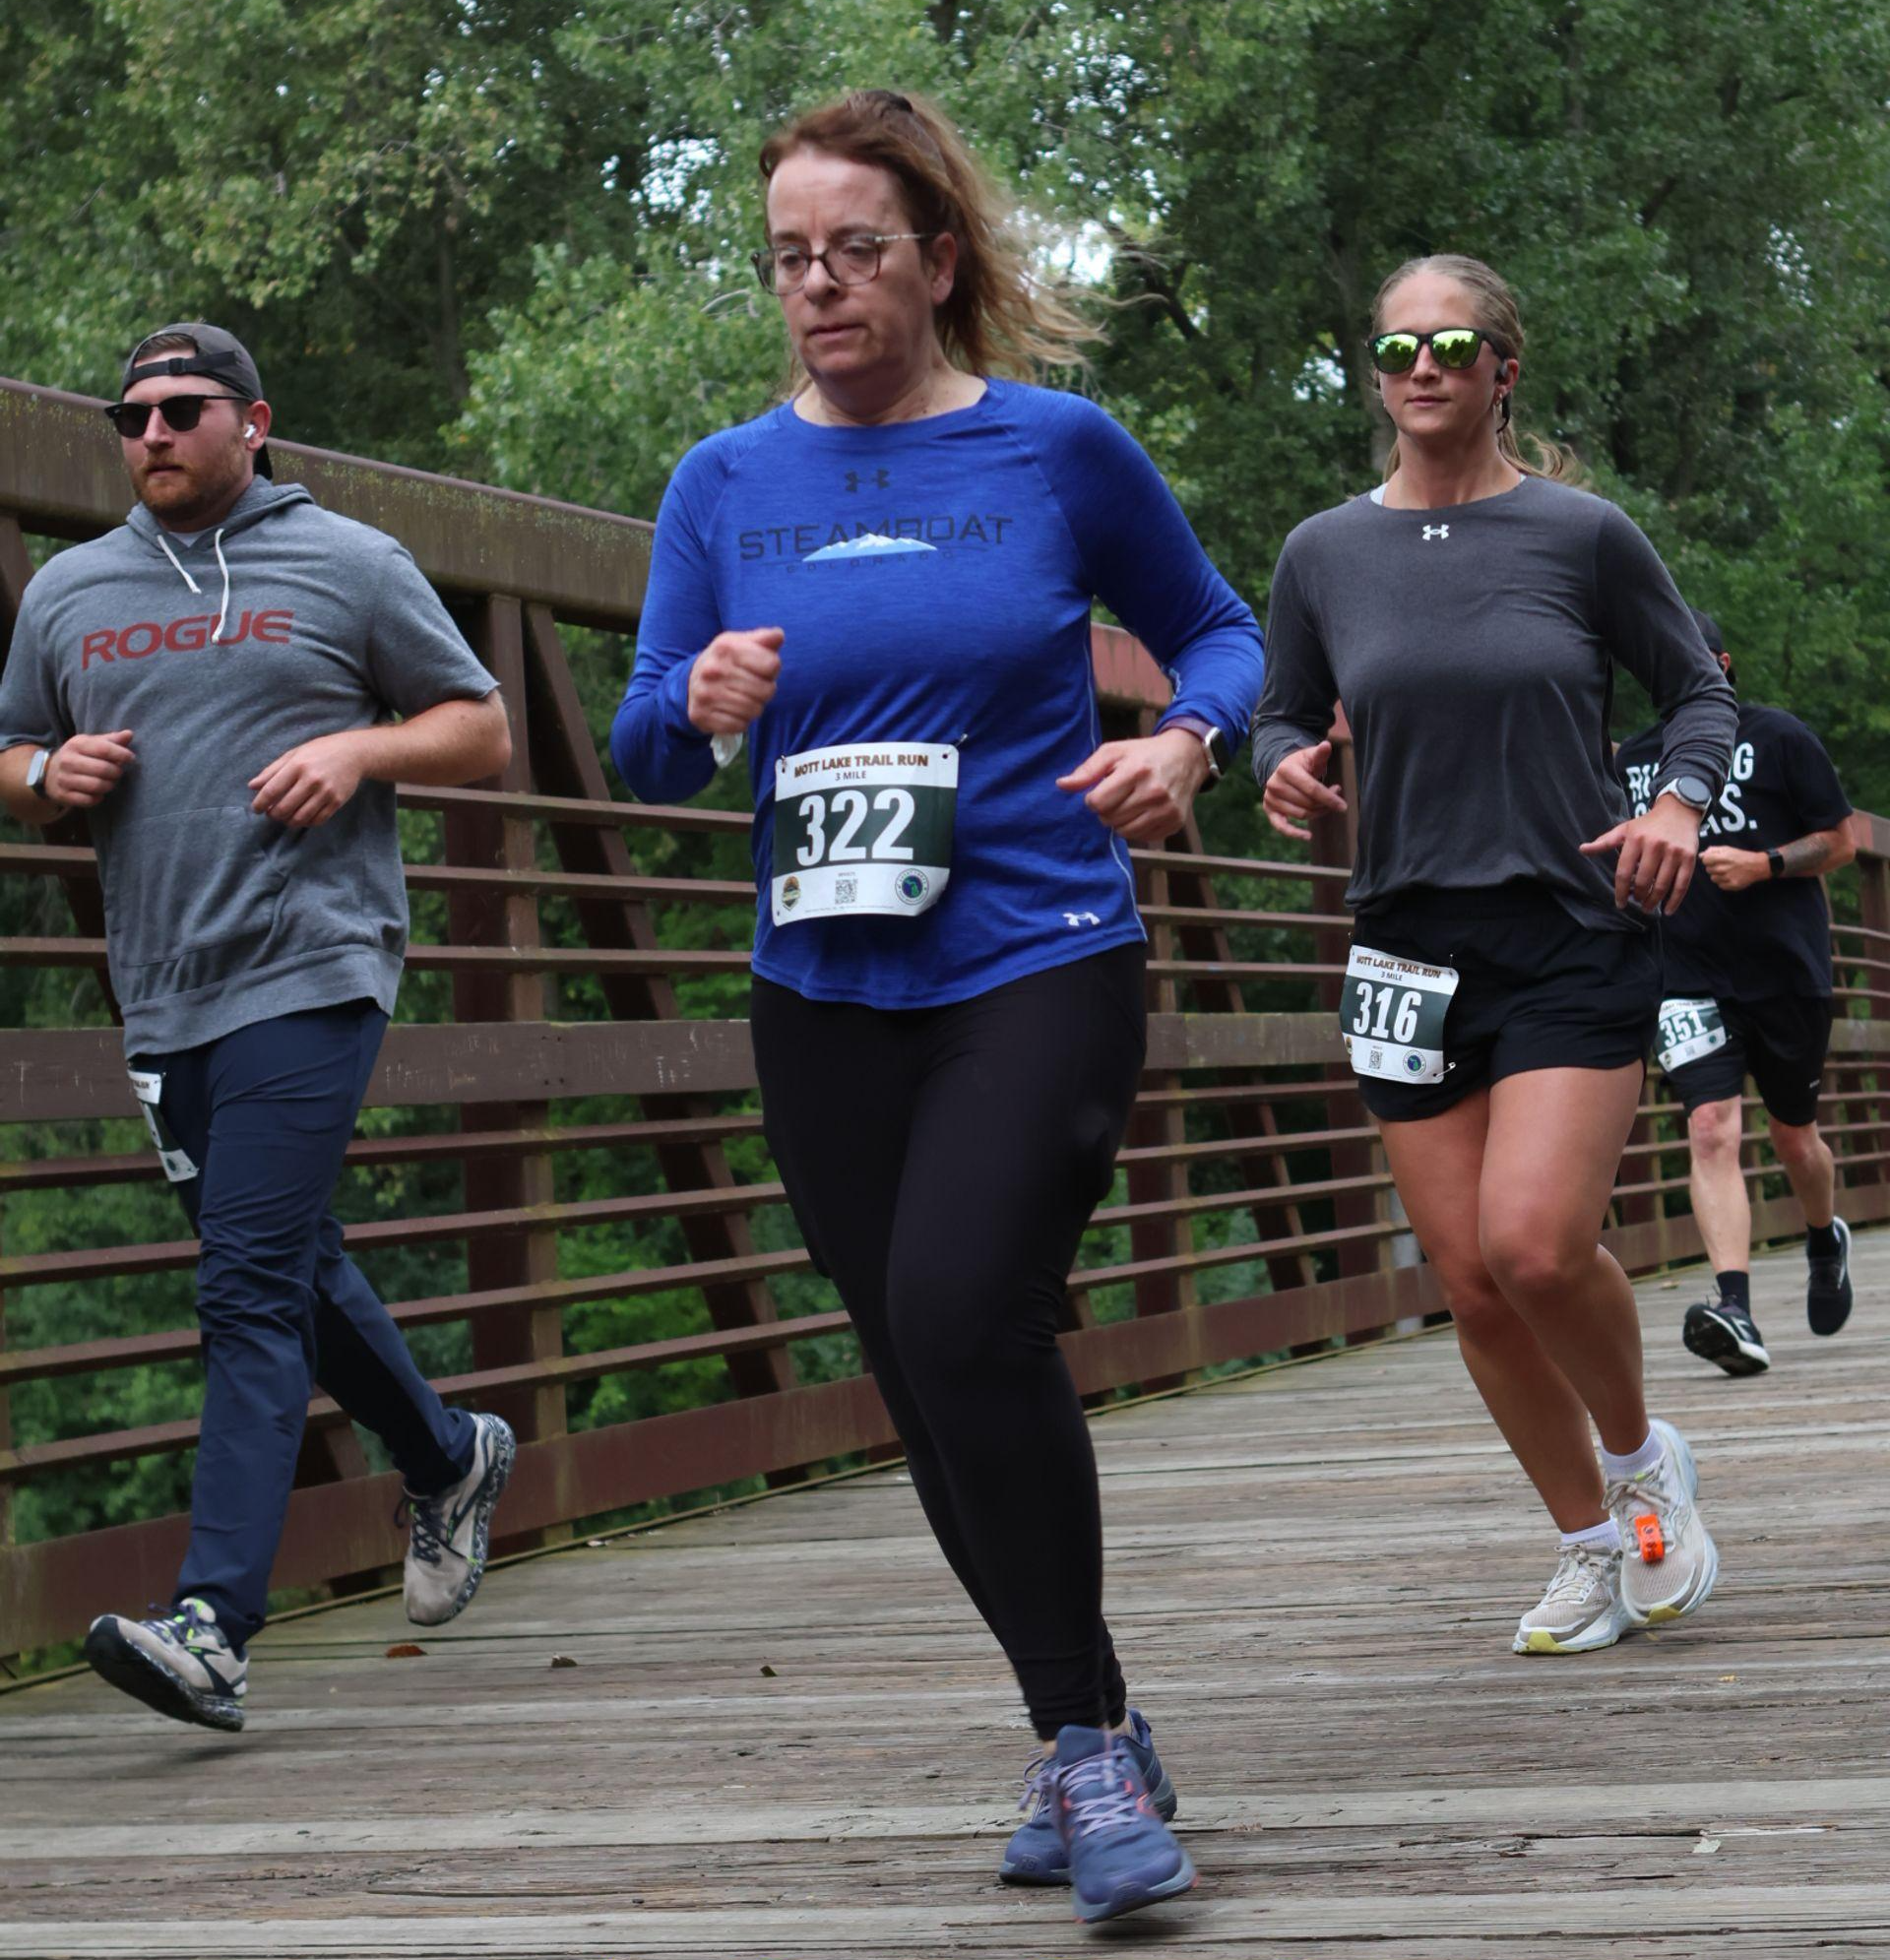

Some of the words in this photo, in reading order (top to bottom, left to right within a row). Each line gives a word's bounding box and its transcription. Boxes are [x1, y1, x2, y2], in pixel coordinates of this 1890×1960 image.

[739, 514, 1013, 560] STEAMBOAT
[82, 609, 294, 670] ROGUE
[793, 761, 819, 778] MOTT
[822, 756, 851, 771] LAKE
[854, 754, 894, 768] TRAIL
[897, 754, 929, 767] RUN
[835, 772, 842, 782] 3
[844, 771, 866, 780] MILE
[796, 788, 915, 867] 322
[1373, 959, 1395, 970] LAKE
[1397, 963, 1419, 975] TRAIL
[1421, 968, 1441, 979] RUN
[1353, 981, 1422, 1043] 316
[1660, 1009, 1708, 1048] 351
